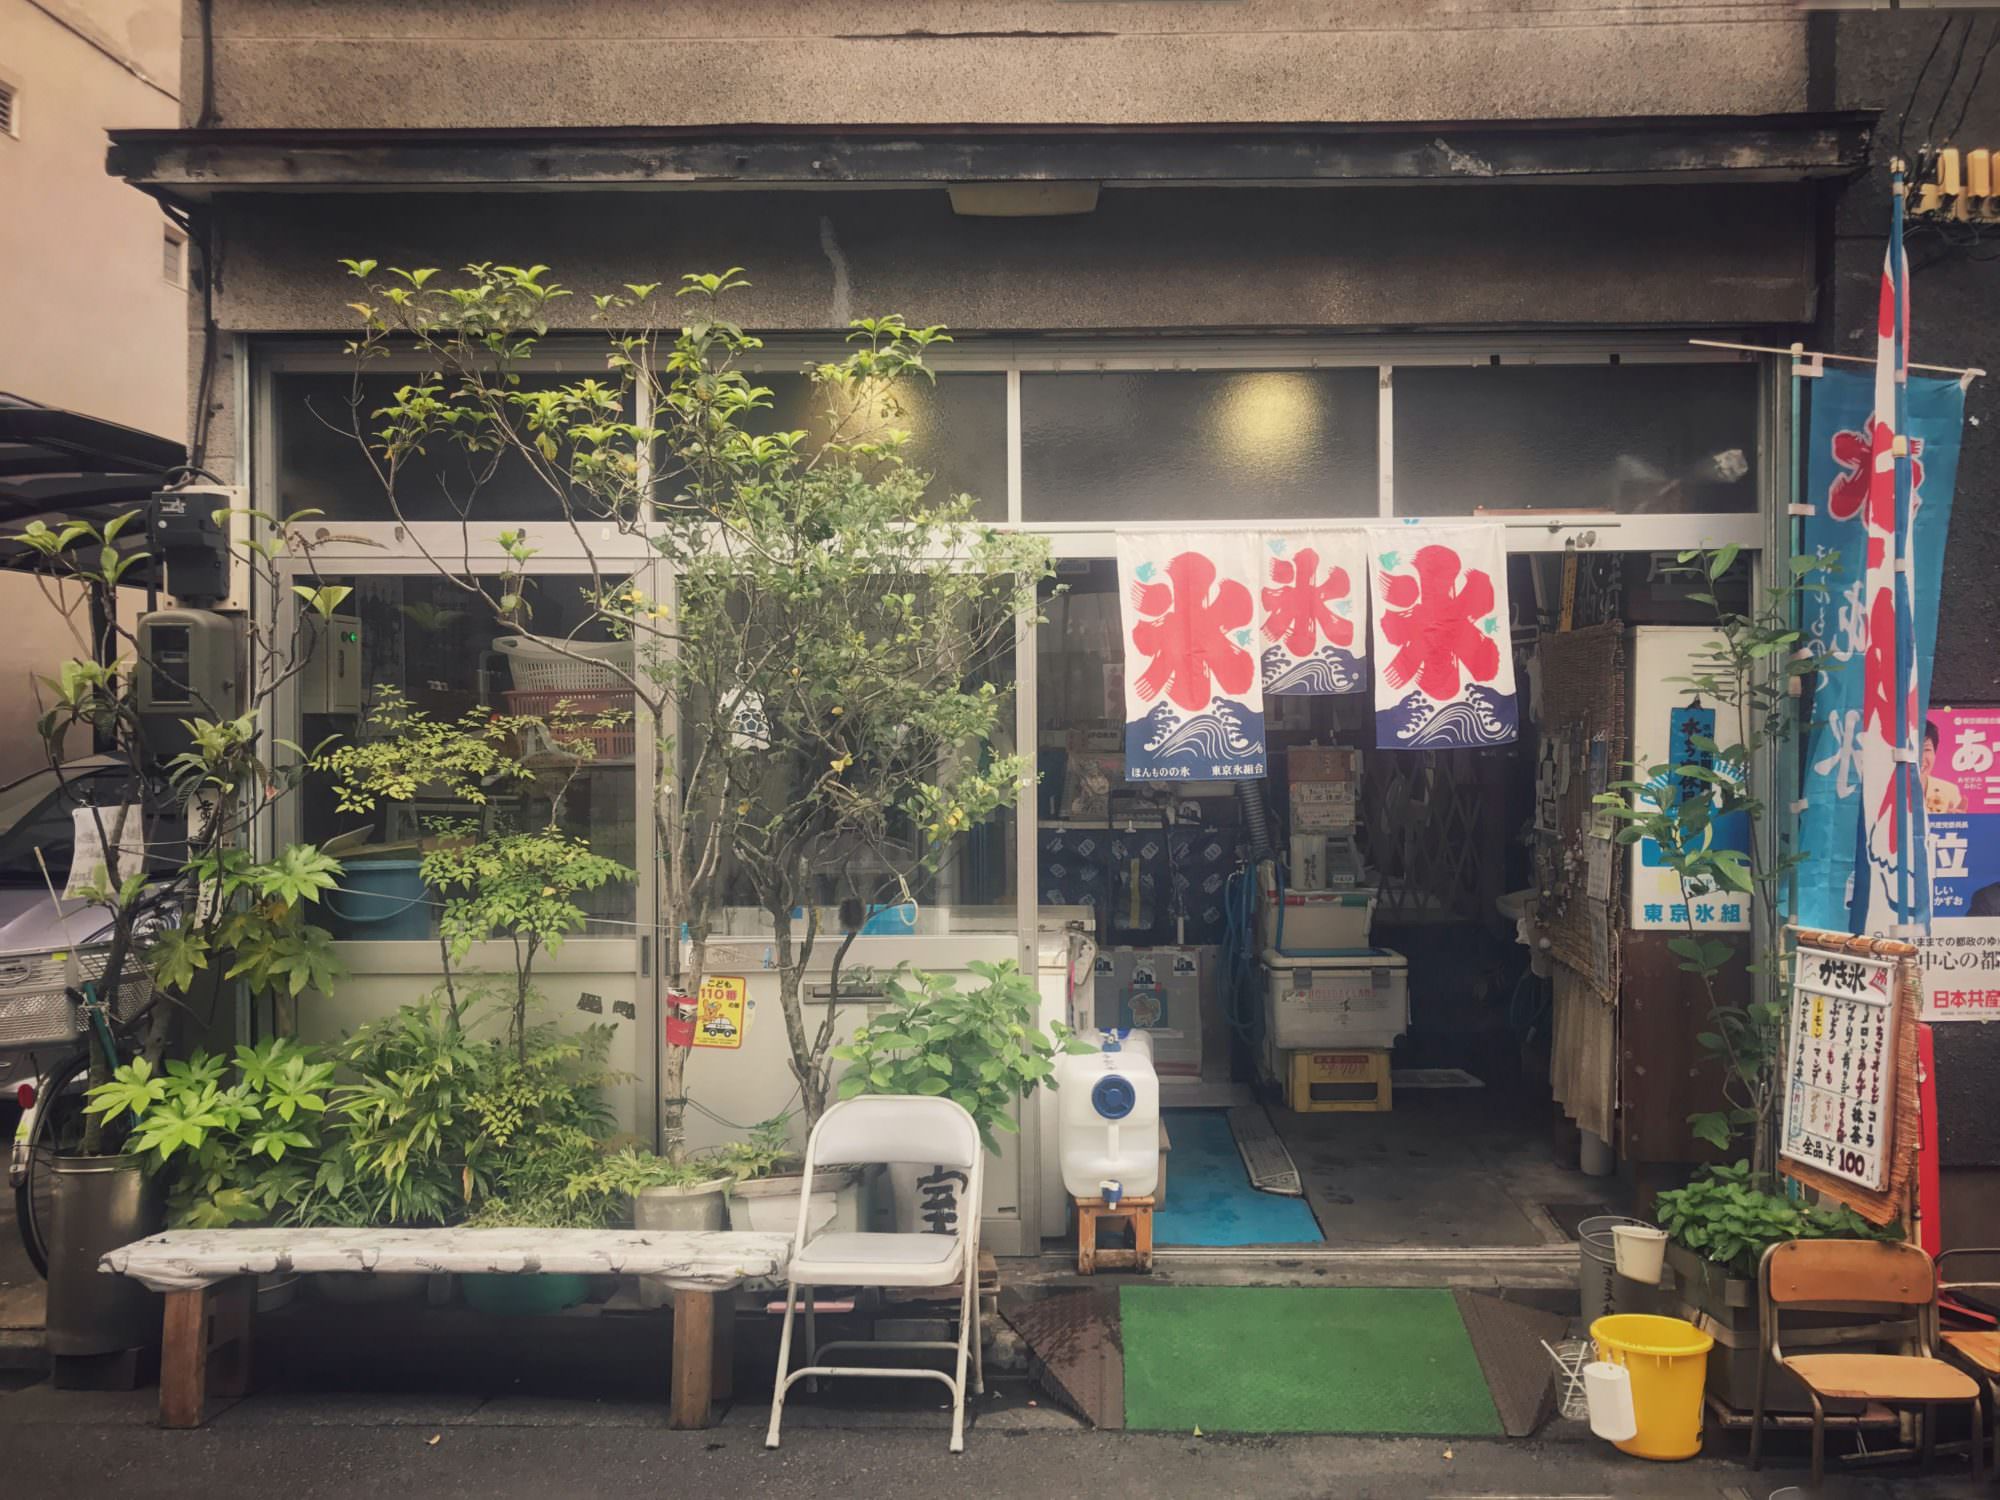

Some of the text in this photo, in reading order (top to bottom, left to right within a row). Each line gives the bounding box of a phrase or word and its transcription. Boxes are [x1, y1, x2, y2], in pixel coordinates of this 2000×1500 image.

[1260, 547, 1354, 657] 氷
[1130, 551, 1255, 712] 氷
[1380, 544, 1500, 701] 氷
[1952, 729, 2000, 773] あ
[1131, 766, 1190, 778] ほんものの氷
[1211, 763, 1264, 776] 東京氷組合
[1928, 832, 1968, 878] 位
[1644, 904, 1740, 923] 東京氷組
[1934, 896, 1963, 906] かずお
[708, 980, 732, 989] こども
[1819, 959, 1867, 994] かき氷
[1934, 989, 2000, 1009] 日本共産
[1866, 1111, 1876, 1148] コーラ
